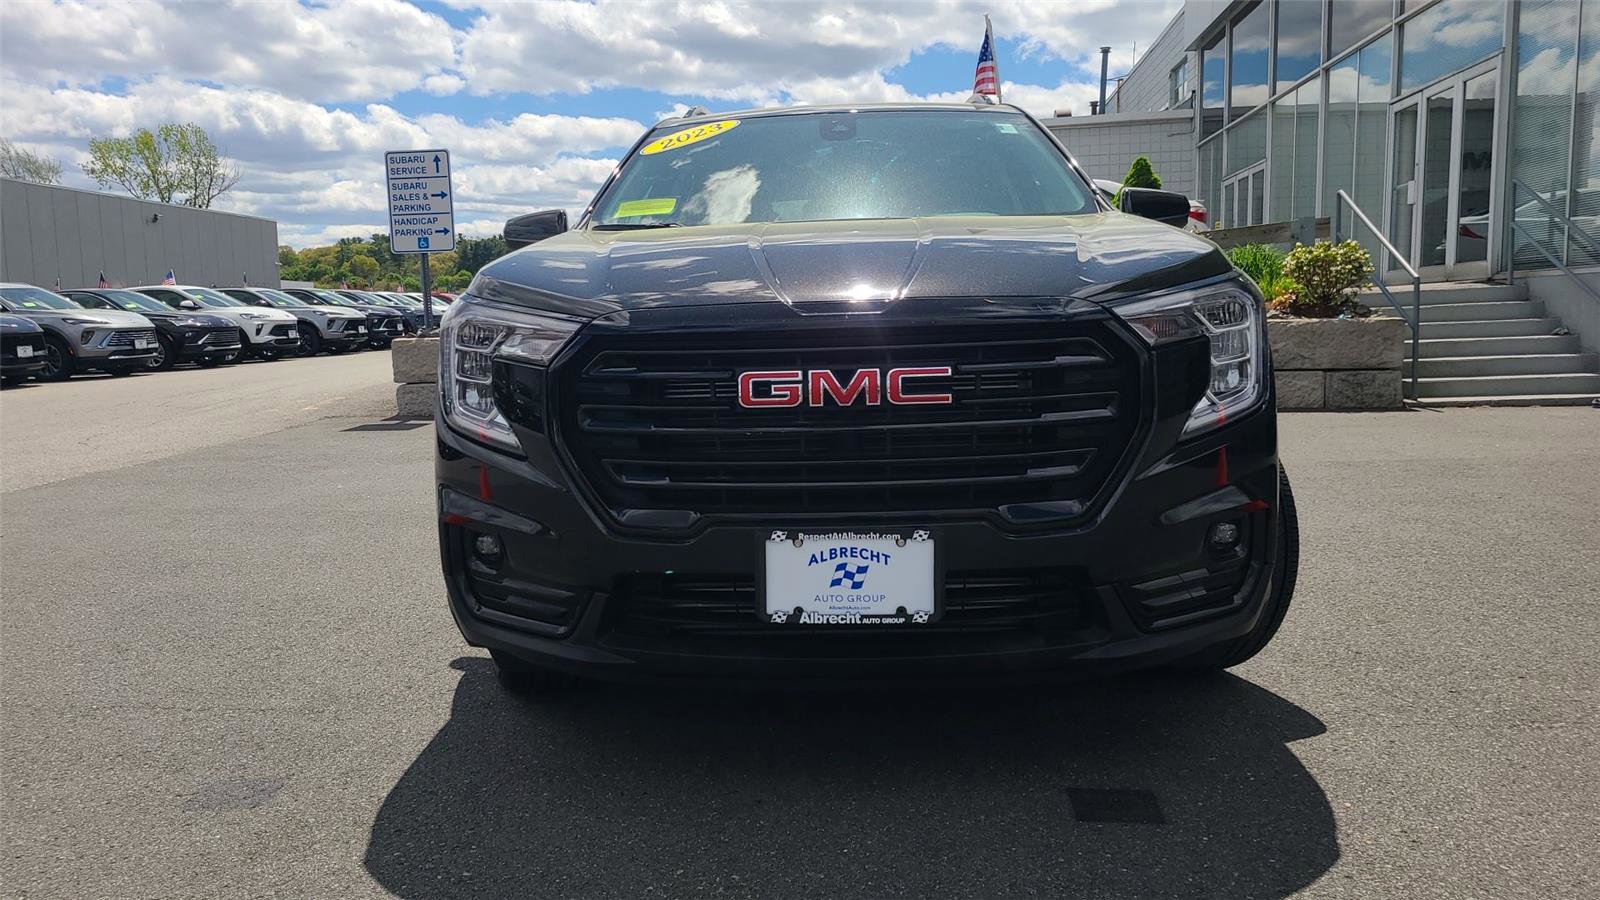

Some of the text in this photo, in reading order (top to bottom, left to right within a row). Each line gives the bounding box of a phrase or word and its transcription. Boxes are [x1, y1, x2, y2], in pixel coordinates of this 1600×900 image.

[661, 124, 722, 149] 2023
[390, 156, 426, 164] SUBARU
[390, 167, 428, 175] SERVICE
[392, 182, 428, 190] SUBARU
[392, 193, 420, 201] SALES
[394, 204, 432, 212] PARKING
[394, 218, 438, 226] HANDICAP
[395, 228, 433, 236] PARKING
[738, 366, 953, 409] GMC
[798, 532, 901, 541] RespectAtAlbrecht.com
[808, 547, 891, 566] ALBRECHT
[814, 594, 886, 602] AUTO GROUP
[800, 611, 861, 624] Albrecht
